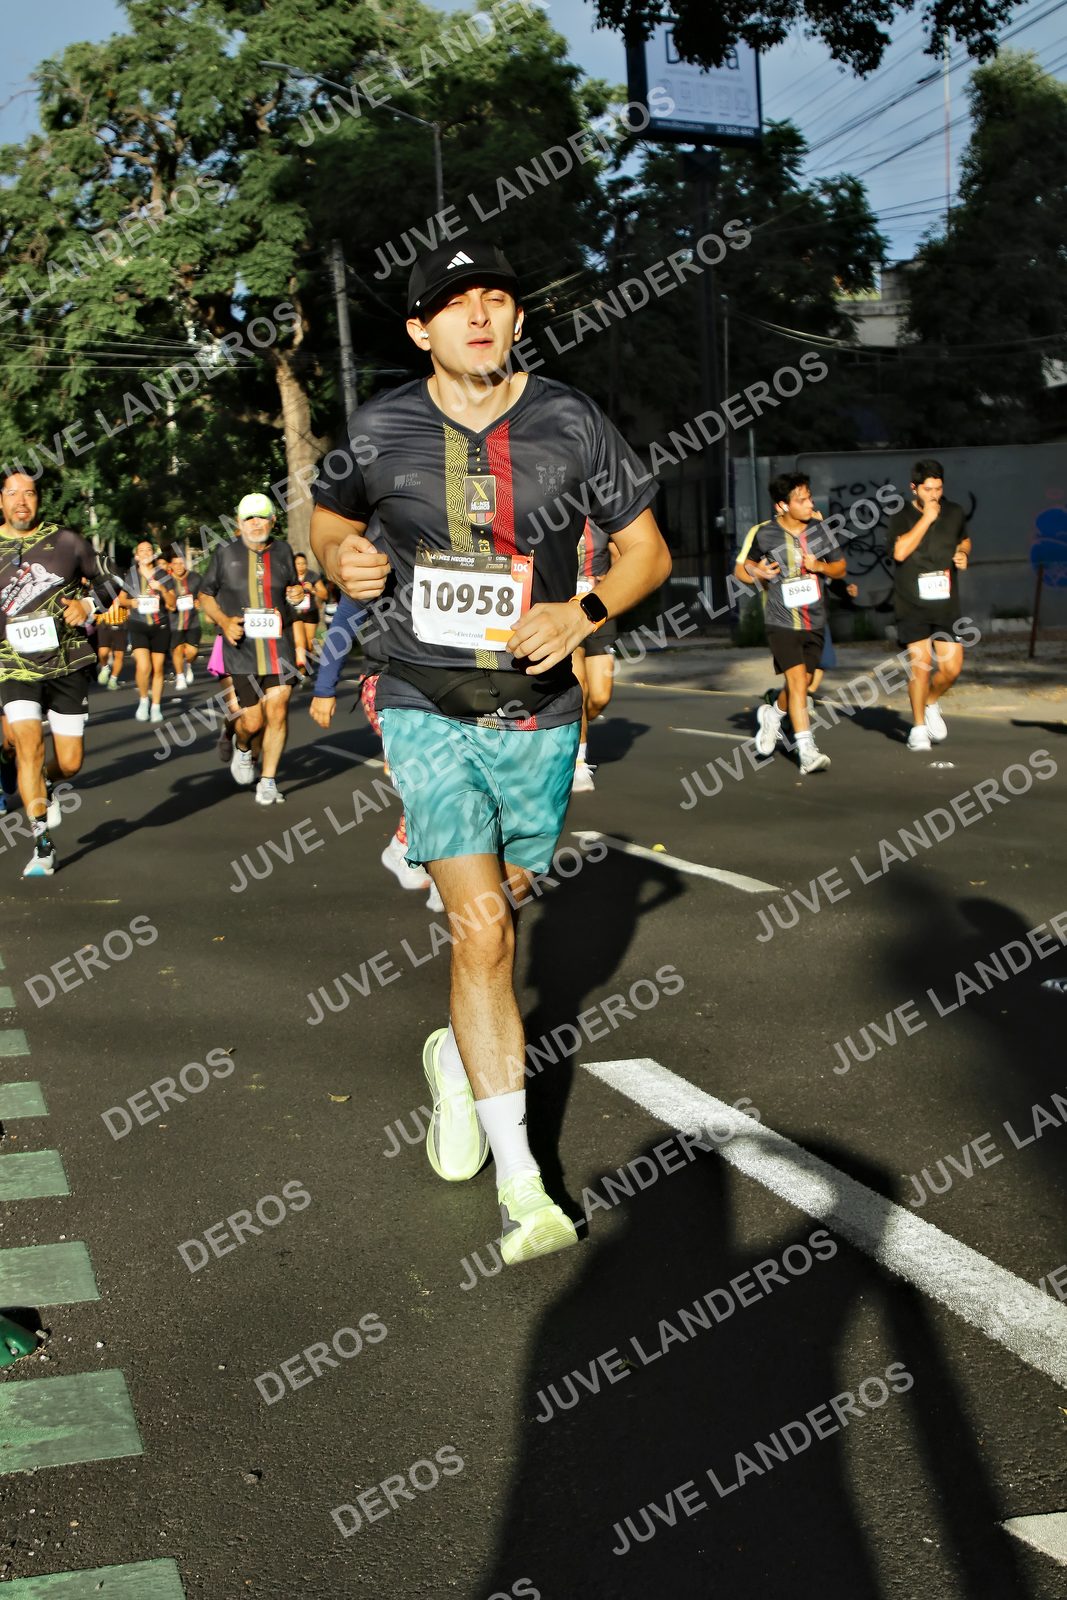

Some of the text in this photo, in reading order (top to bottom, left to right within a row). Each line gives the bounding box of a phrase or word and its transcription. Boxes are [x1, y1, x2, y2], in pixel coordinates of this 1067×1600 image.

[419, 579, 515, 617] 10958
[249, 617, 275, 628] 8530
[15, 623, 47, 640] 1095
